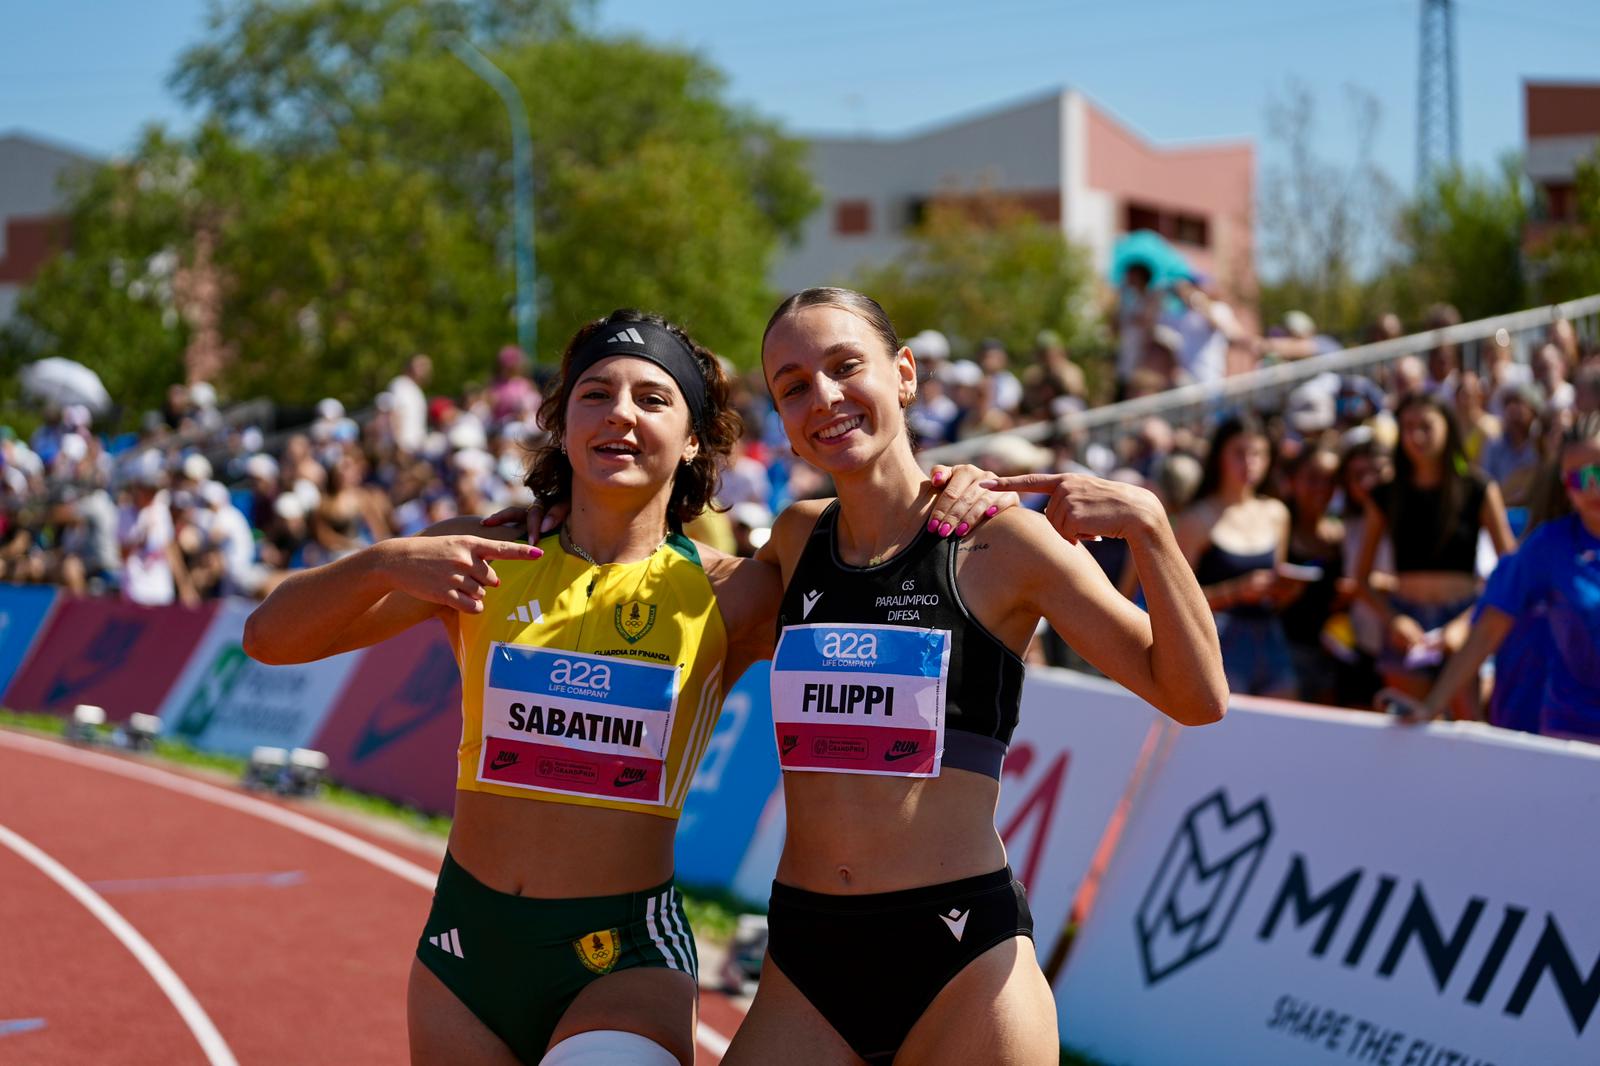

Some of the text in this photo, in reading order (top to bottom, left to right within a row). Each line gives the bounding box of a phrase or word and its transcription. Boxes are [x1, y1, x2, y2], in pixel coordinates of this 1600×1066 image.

[902, 579, 914, 591] GS
[875, 594, 939, 607] PARALIMPICO
[887, 609, 920, 621] DIFESA
[822, 632, 878, 659] a2a
[638, 649, 670, 661] FINANZA
[822, 659, 876, 668] LIFE COMPANY
[550, 658, 611, 690] a2a
[549, 684, 609, 698] LIFE COMPANY
[802, 683, 894, 716] FILIPPI
[508, 702, 644, 748] SABATINI
[892, 740, 919, 753] RUN
[496, 751, 519, 763] RUN
[622, 767, 648, 779] RUN
[1266, 994, 1351, 1051] SHAPE
[1347, 1019, 1404, 1066] THE
